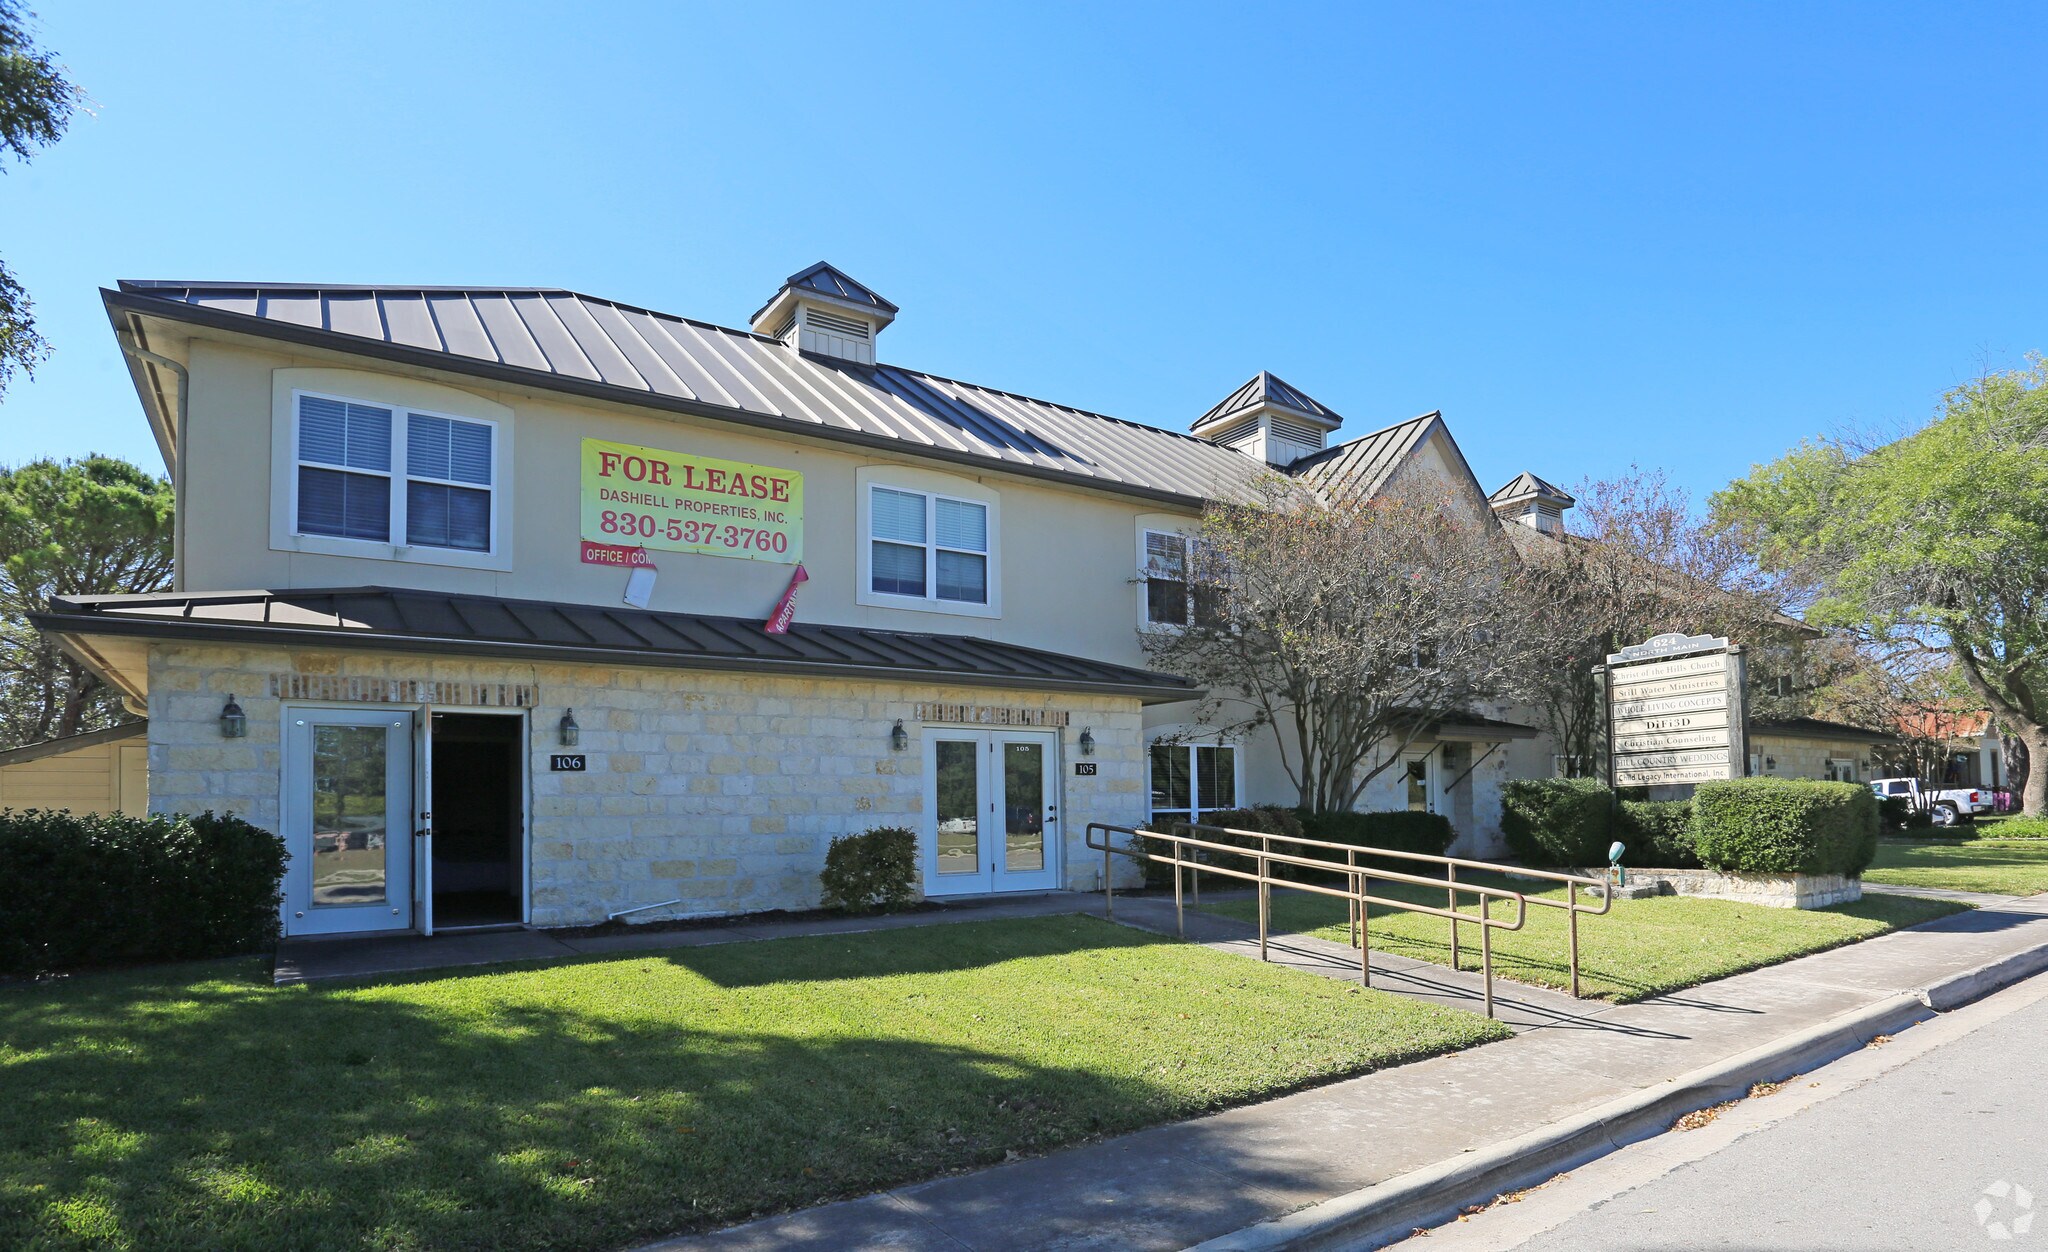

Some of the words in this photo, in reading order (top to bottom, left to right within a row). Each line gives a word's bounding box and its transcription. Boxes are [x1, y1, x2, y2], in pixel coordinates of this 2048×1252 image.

[598, 451, 672, 487] FOR
[683, 464, 789, 503] LEASE
[600, 488, 669, 509] DASHIELL
[675, 498, 760, 522] PROPERTIES,
[764, 510, 788, 524] INC.
[600, 510, 788, 554] 830-537-3760
[586, 548, 623, 563] OFFICE
[1632, 648, 1668, 657] NORTH
[1672, 642, 1699, 651] MAIN
[1653, 637, 1677, 647] 624
[1615, 669, 1639, 680] Christ
[1641, 668, 1650, 676] of
[1651, 666, 1664, 675] the
[1666, 664, 1687, 674] Hills
[1690, 660, 1720, 670] Church
[1618, 687, 1637, 697] Still
[1640, 685, 1666, 696] Water
[1669, 678, 1719, 692] Ministries
[1616, 704, 1645, 714] WHOLE
[1647, 701, 1676, 711] LIVING
[1678, 697, 1722, 708] CONCEPTS
[1624, 738, 1664, 747] Christian
[1666, 734, 1717, 744] Counseling
[556, 756, 581, 769] 106
[1616, 759, 1634, 767] HILL
[1637, 756, 1678, 766] COUNTRY
[1679, 753, 1728, 763] WEDDINGS
[1079, 764, 1094, 774] 105
[1618, 772, 1636, 781] Child
[1637, 772, 1661, 781] Legacy
